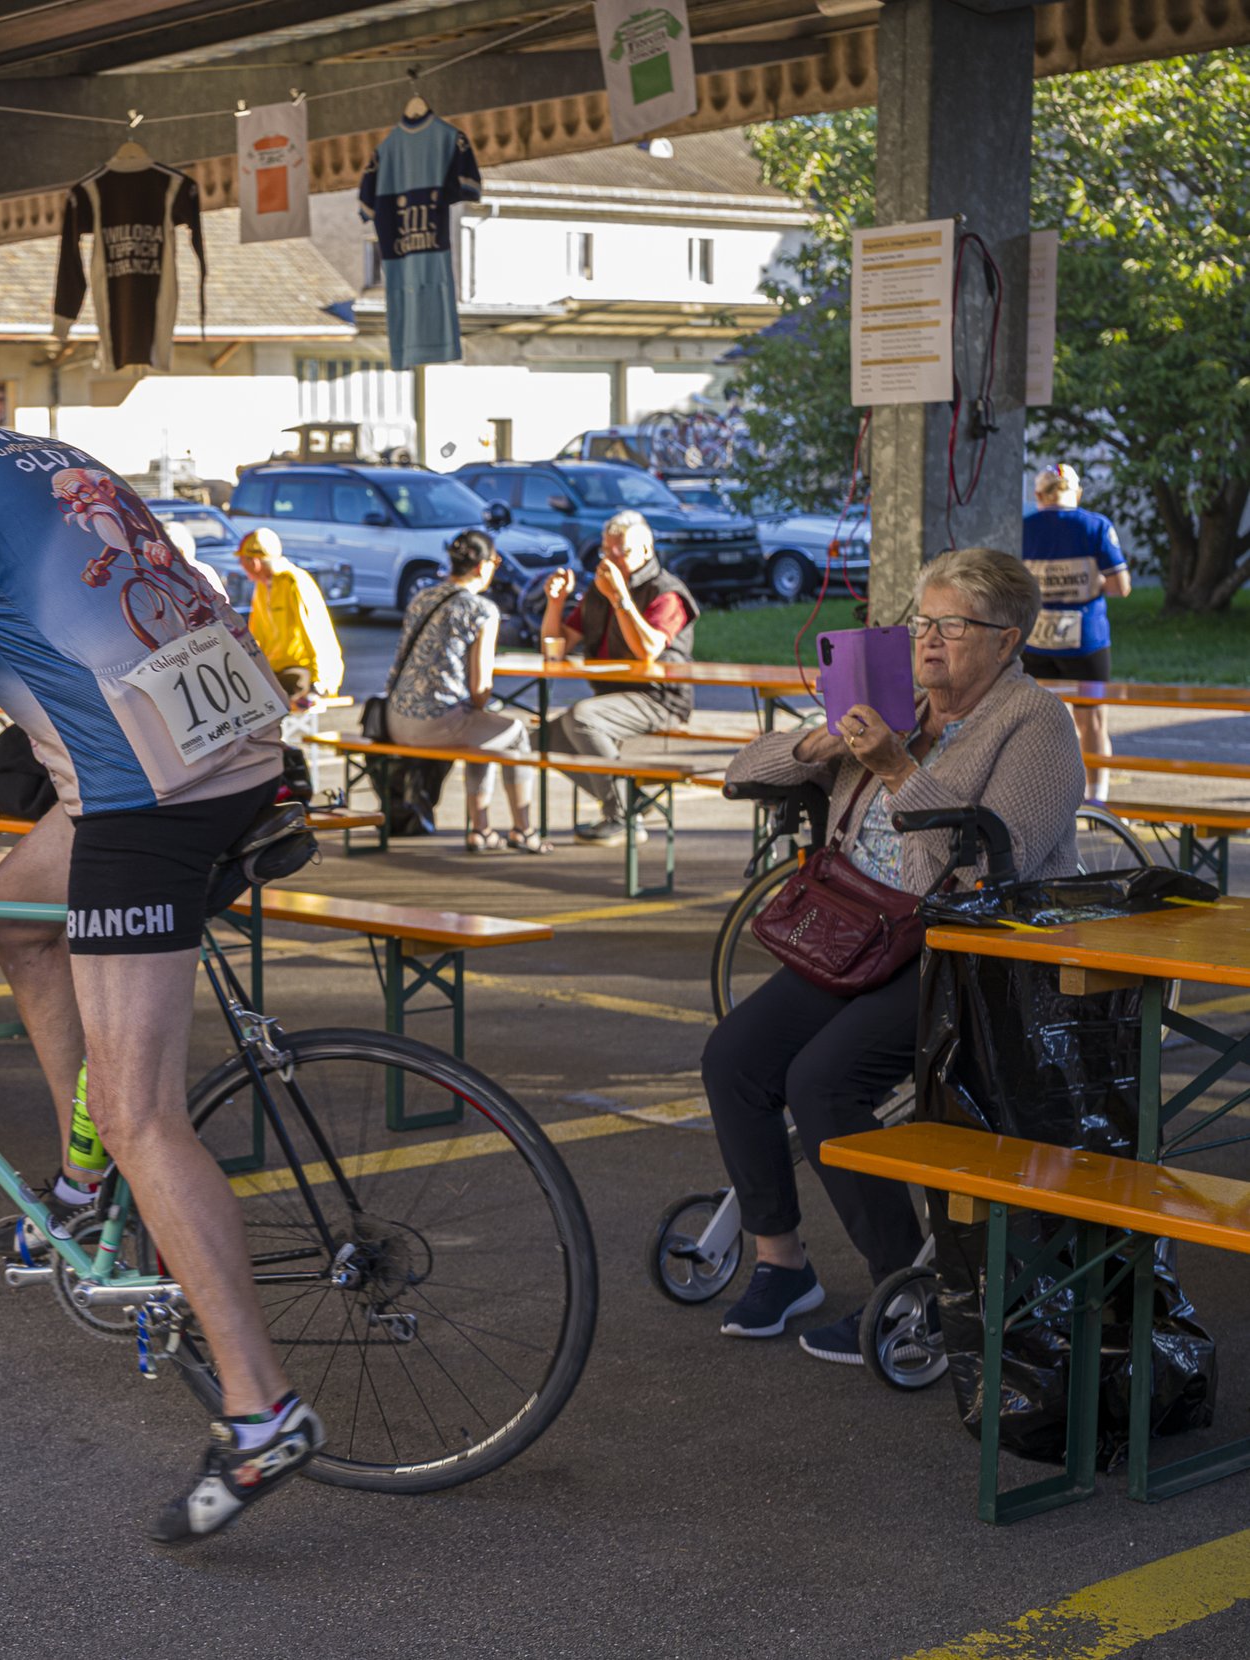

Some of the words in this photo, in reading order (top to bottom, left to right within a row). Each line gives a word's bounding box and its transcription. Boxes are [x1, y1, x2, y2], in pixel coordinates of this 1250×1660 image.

[15, 449, 70, 473] OLD
[150, 647, 191, 673] Chläggi
[187, 635, 221, 657] Classic
[172, 651, 251, 732] 106
[66, 903, 175, 939] BIANCHI
